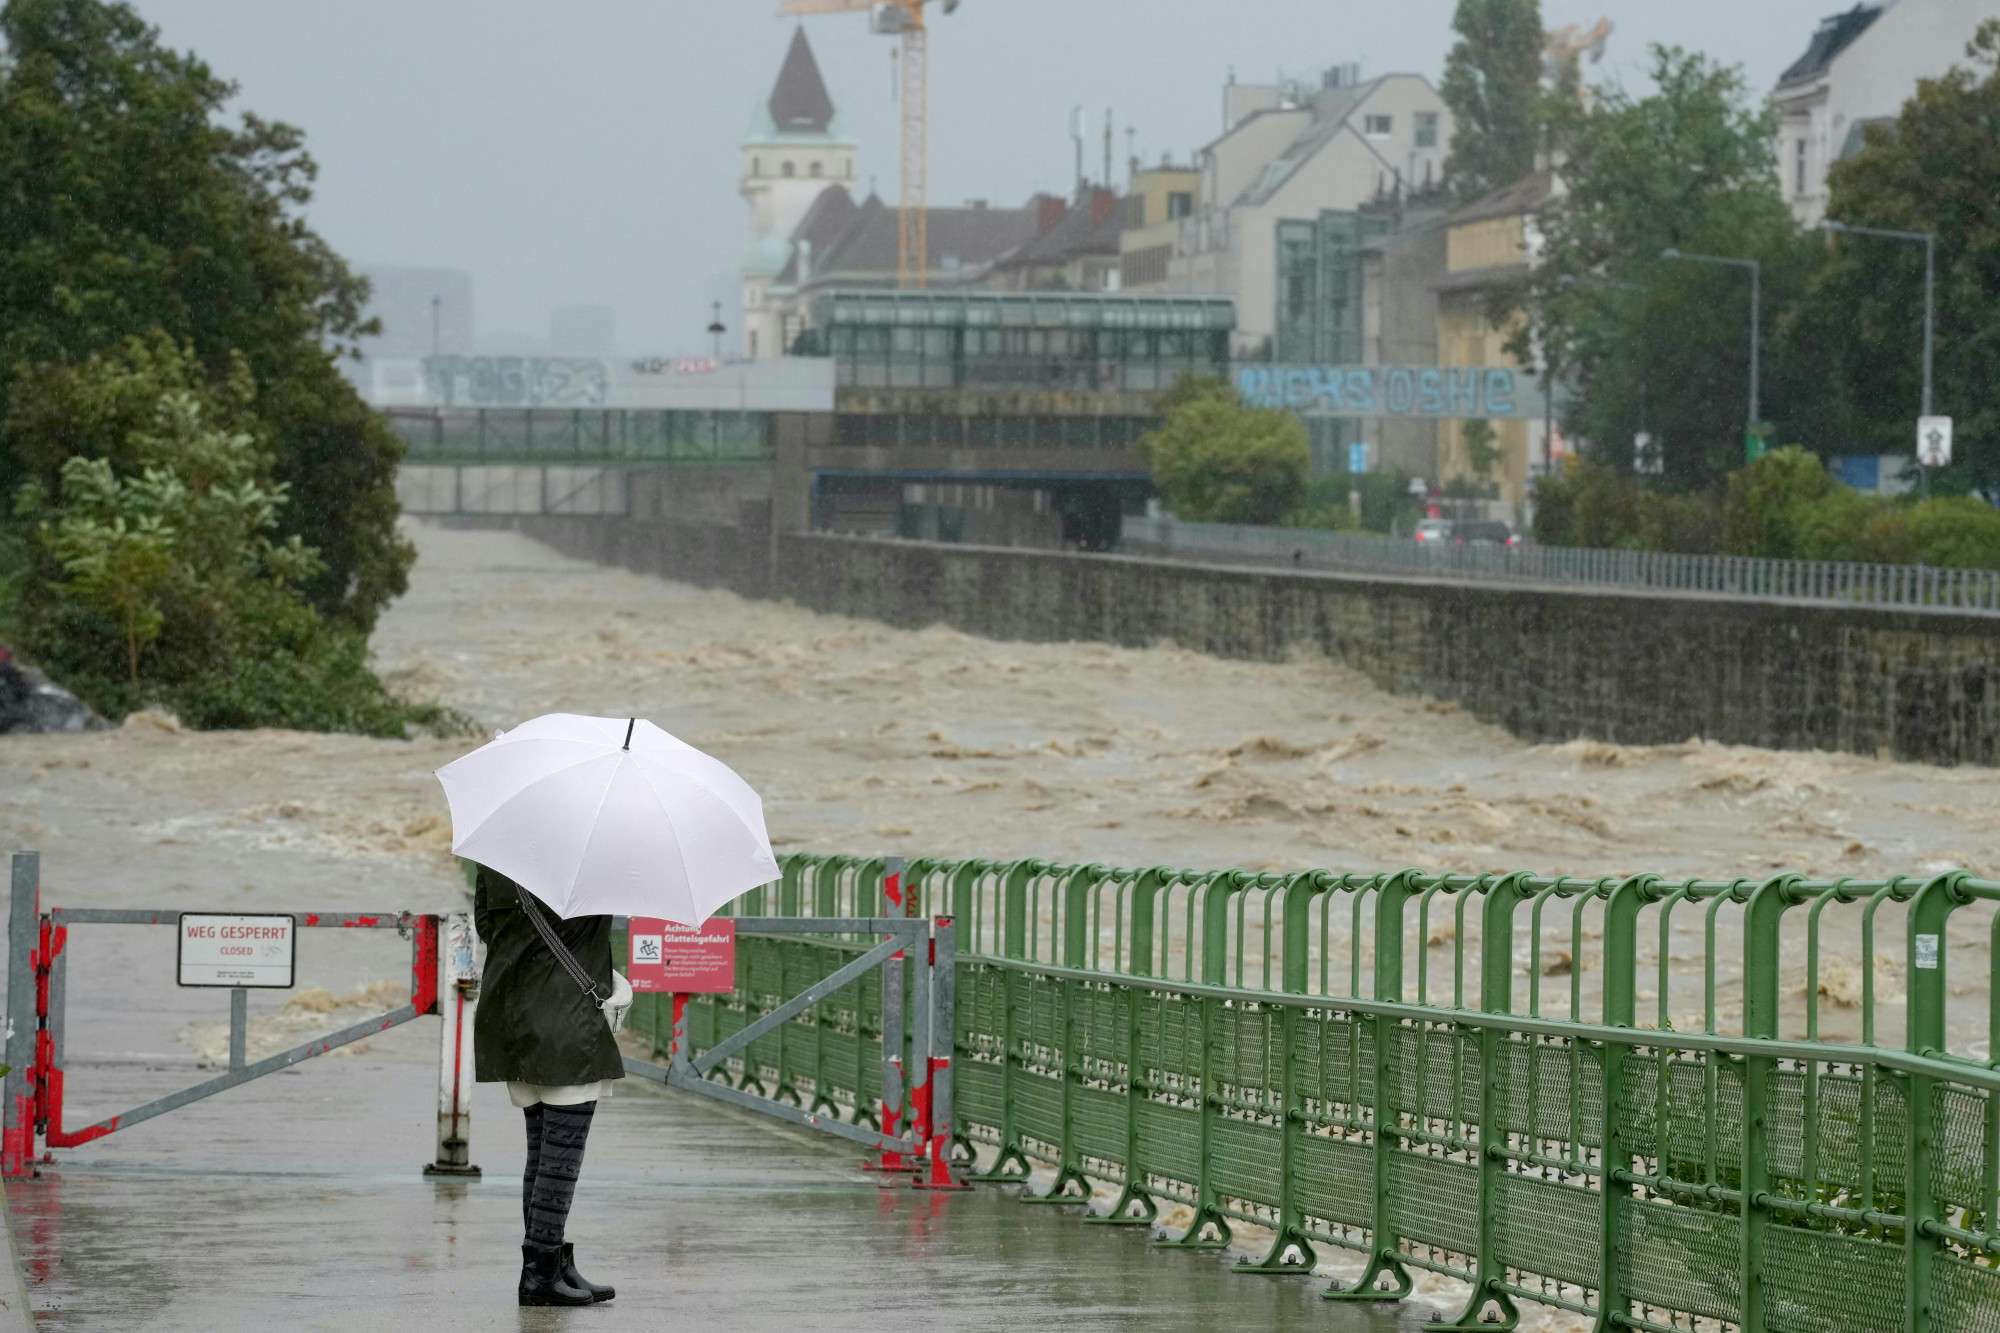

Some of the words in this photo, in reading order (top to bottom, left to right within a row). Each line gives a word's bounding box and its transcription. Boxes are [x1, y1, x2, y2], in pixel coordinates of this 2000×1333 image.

[187, 926, 215, 938] WEG
[220, 926, 287, 939] GESPERRT
[664, 924, 702, 934] Achtung
[664, 934, 730, 944] Glatteisgefahr!
[219, 946, 253, 956] CLOSED
